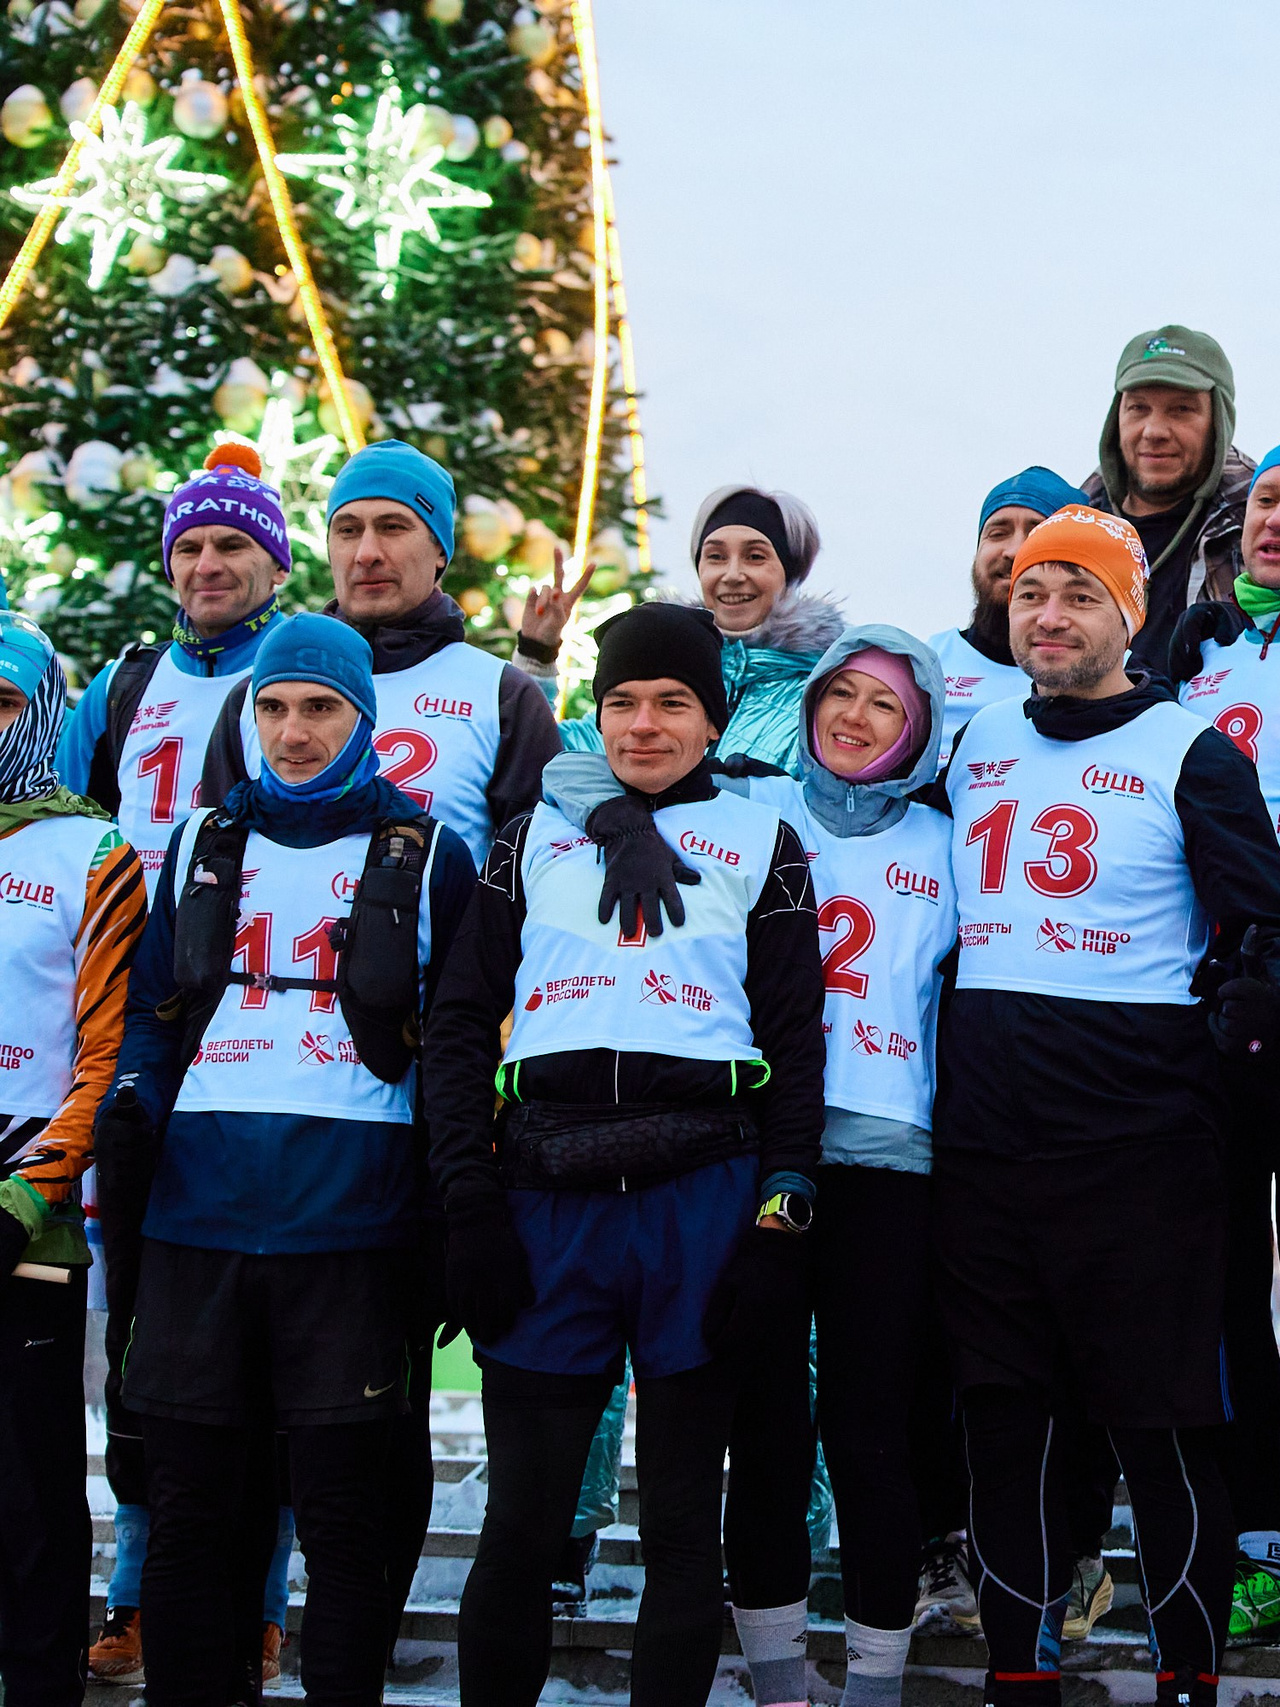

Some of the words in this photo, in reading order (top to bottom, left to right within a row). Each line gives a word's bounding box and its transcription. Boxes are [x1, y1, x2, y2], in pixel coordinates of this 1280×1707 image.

[164, 498, 284, 544] ARATHON
[424, 697, 473, 717] НЦВ
[138, 737, 202, 824] 1
[1091, 770, 1145, 795] НЦВ
[689, 835, 741, 867] НЦВ
[966, 800, 1098, 899] 13
[6, 878, 55, 906] НЦВ
[895, 868, 940, 899] НЦВ
[1083, 928, 1131, 944] ППОО
[1082, 941, 1117, 955] НЦВ
[232, 912, 340, 1014] 11
[547, 975, 616, 993] ВЕРТОЛЕТЫ
[682, 983, 719, 1002] ППО
[547, 988, 590, 1006] РОССИИ
[682, 995, 711, 1011] НЦВ
[0, 1044, 34, 1060] ПОО
[207, 1039, 274, 1051] ВЕРТОЛЕТЫ
[0, 1056, 21, 1070] ЦВ
[204, 1052, 250, 1064] РОССИИ
